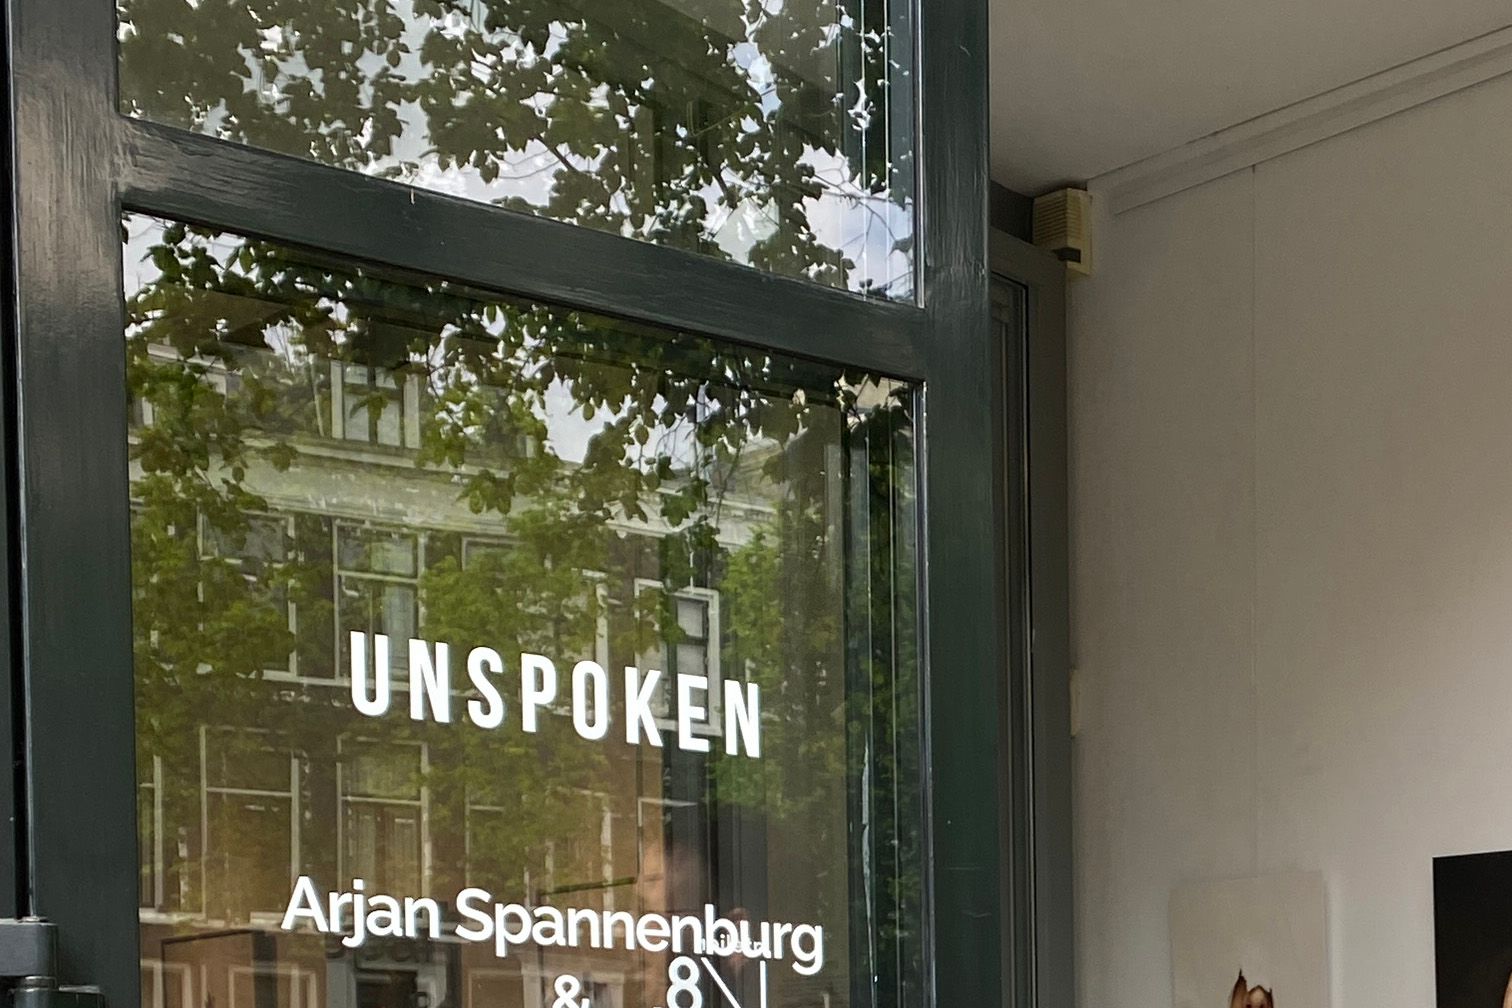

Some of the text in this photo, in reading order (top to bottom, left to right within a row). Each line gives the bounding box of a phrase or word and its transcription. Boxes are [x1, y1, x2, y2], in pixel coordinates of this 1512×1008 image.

[350, 630, 760, 758] UNSPOKEN
[281, 875, 824, 975] Arjan Spannenburg
